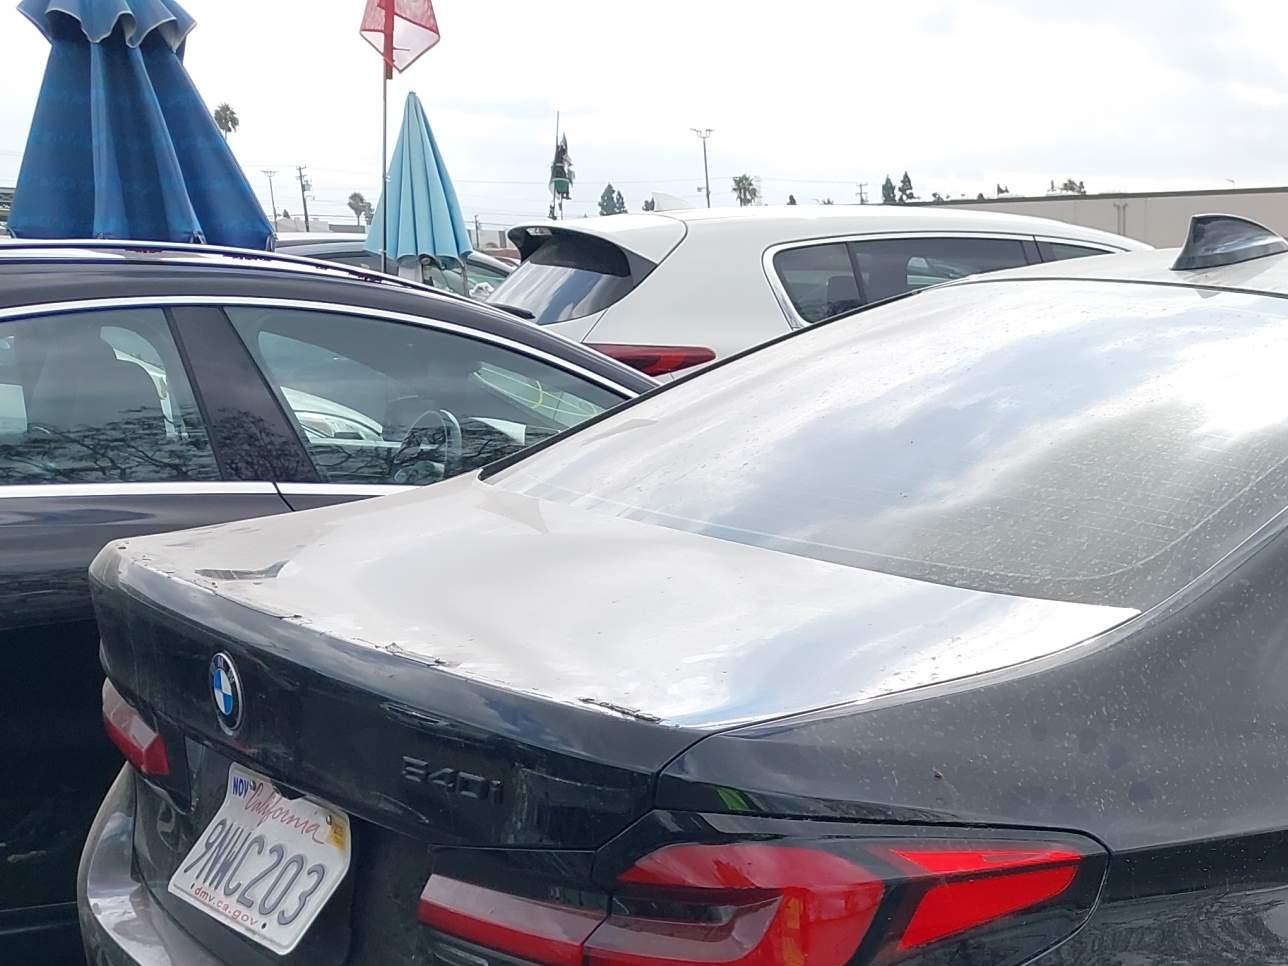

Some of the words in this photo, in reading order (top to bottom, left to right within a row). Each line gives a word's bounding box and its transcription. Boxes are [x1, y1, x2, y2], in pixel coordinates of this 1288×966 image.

[232, 775, 250, 799] NOV
[402, 755, 504, 805] 540i
[244, 782, 325, 845] California
[184, 818, 326, 926] 9NWC203
[194, 887, 259, 926] dmv.ca.gov
